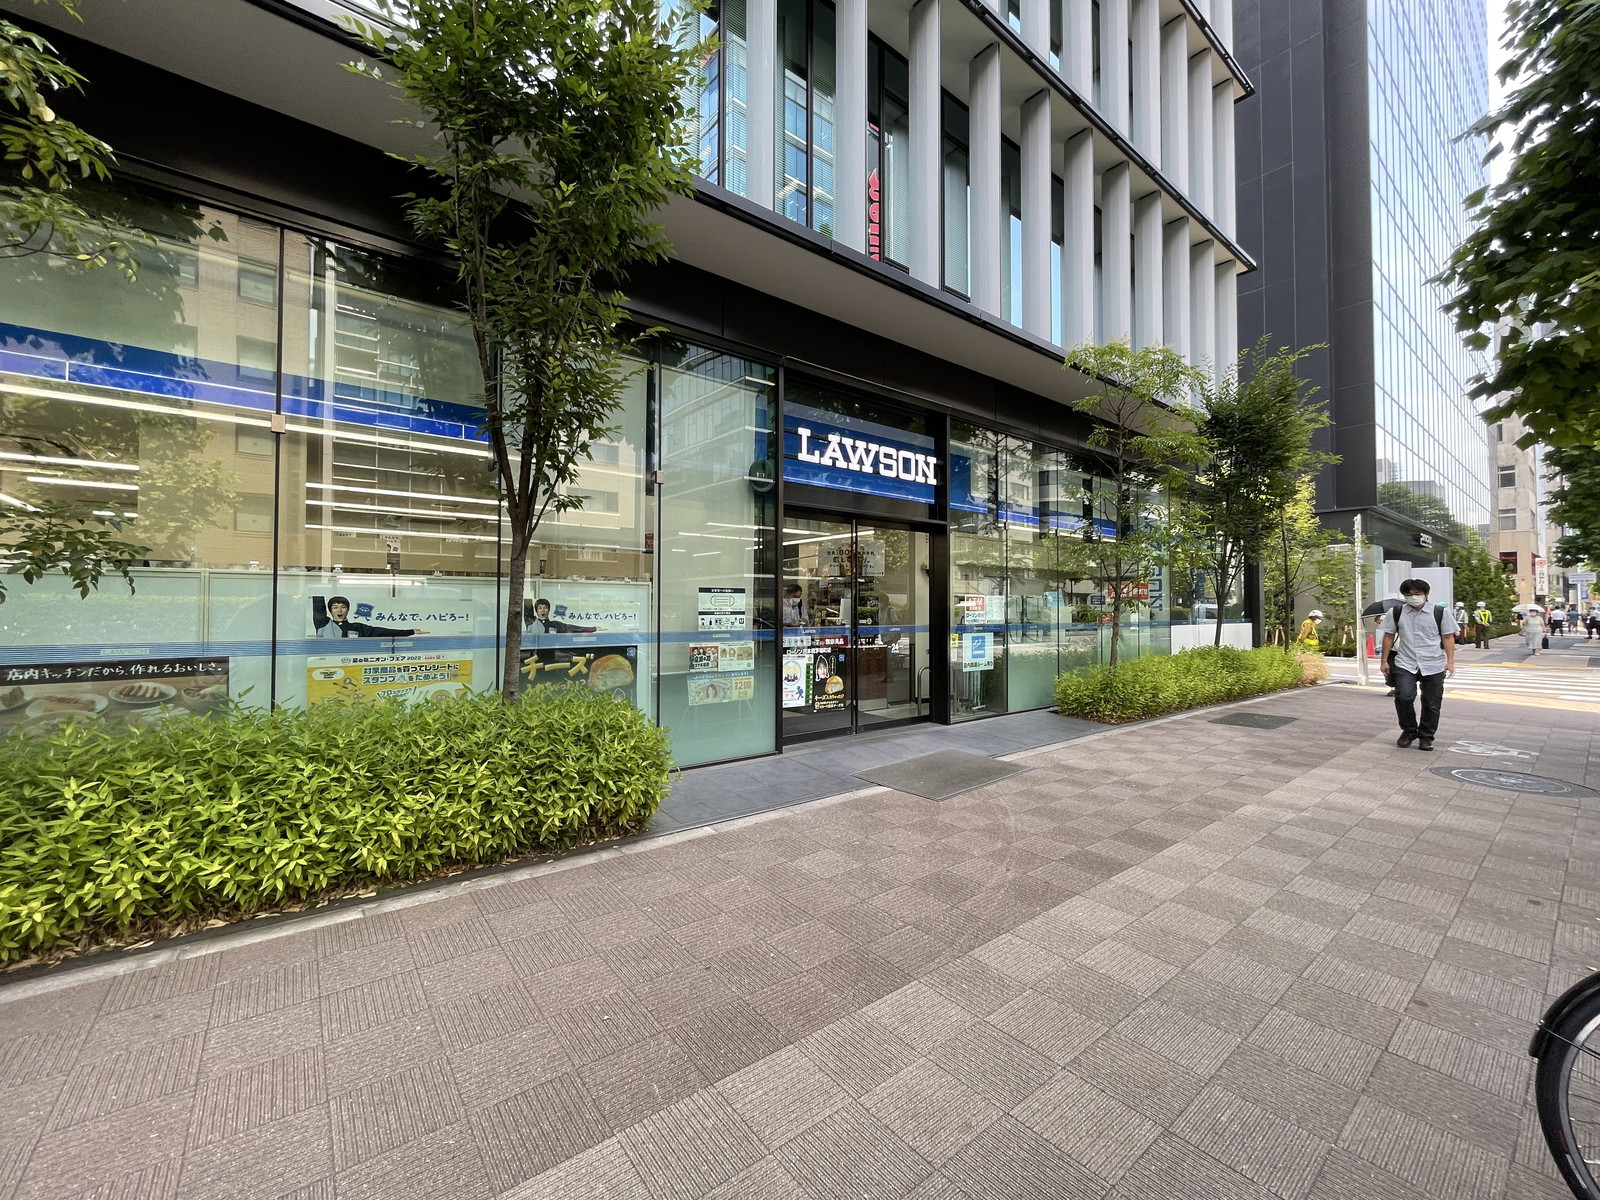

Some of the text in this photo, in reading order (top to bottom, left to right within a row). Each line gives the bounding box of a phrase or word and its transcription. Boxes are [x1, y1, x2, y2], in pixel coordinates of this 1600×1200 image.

[797, 427, 937, 485] LAWSON
[375, 612, 469, 622] みんなで、ハピろー!
[568, 612, 637, 620] みんなで、ハピろー!
[363, 664, 460, 675] 対象商品を買ってレシートに
[520, 653, 595, 681] チーズ
[362, 674, 450, 684] スタンプ をためよう!
